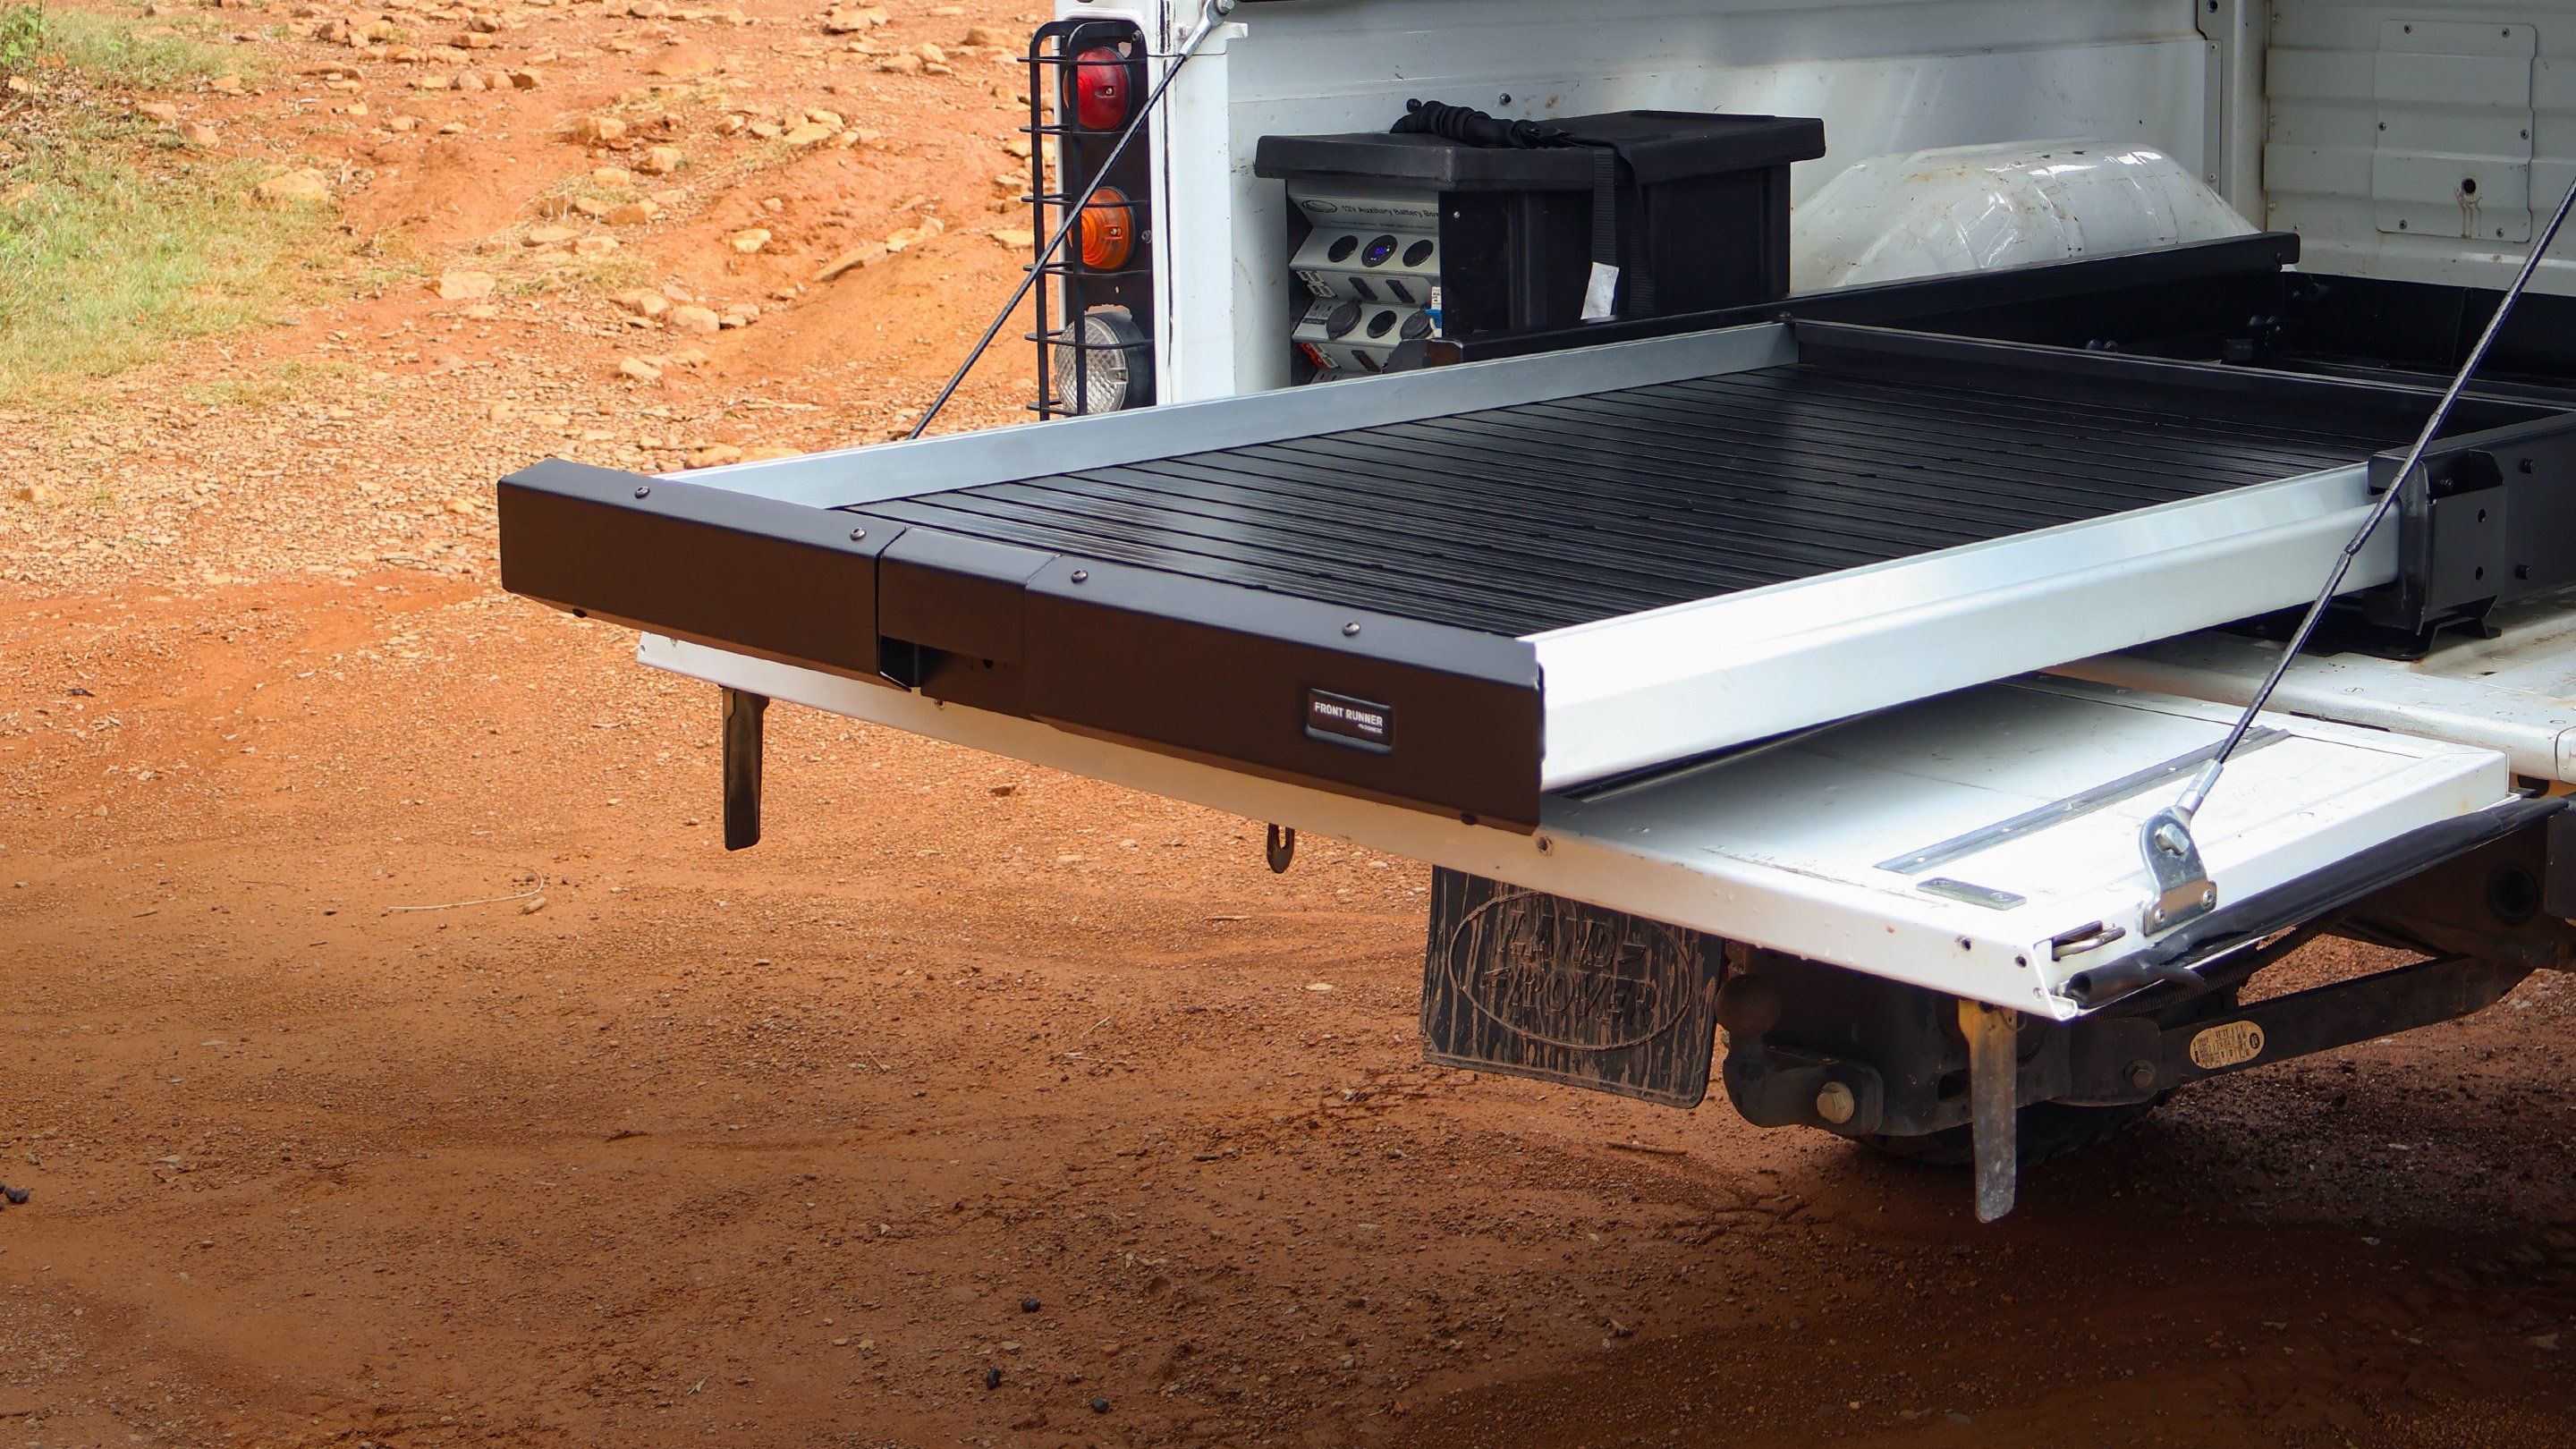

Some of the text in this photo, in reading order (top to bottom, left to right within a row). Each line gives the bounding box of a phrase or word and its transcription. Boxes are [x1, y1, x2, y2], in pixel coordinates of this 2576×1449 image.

[1358, 207, 1392, 216] Auxiliary
[1393, 208, 1422, 217] Battery
[1315, 701, 1383, 726] FRONT RUNNER
[1497, 910, 1617, 969] LAND
[1510, 962, 1658, 1028] ROVER
